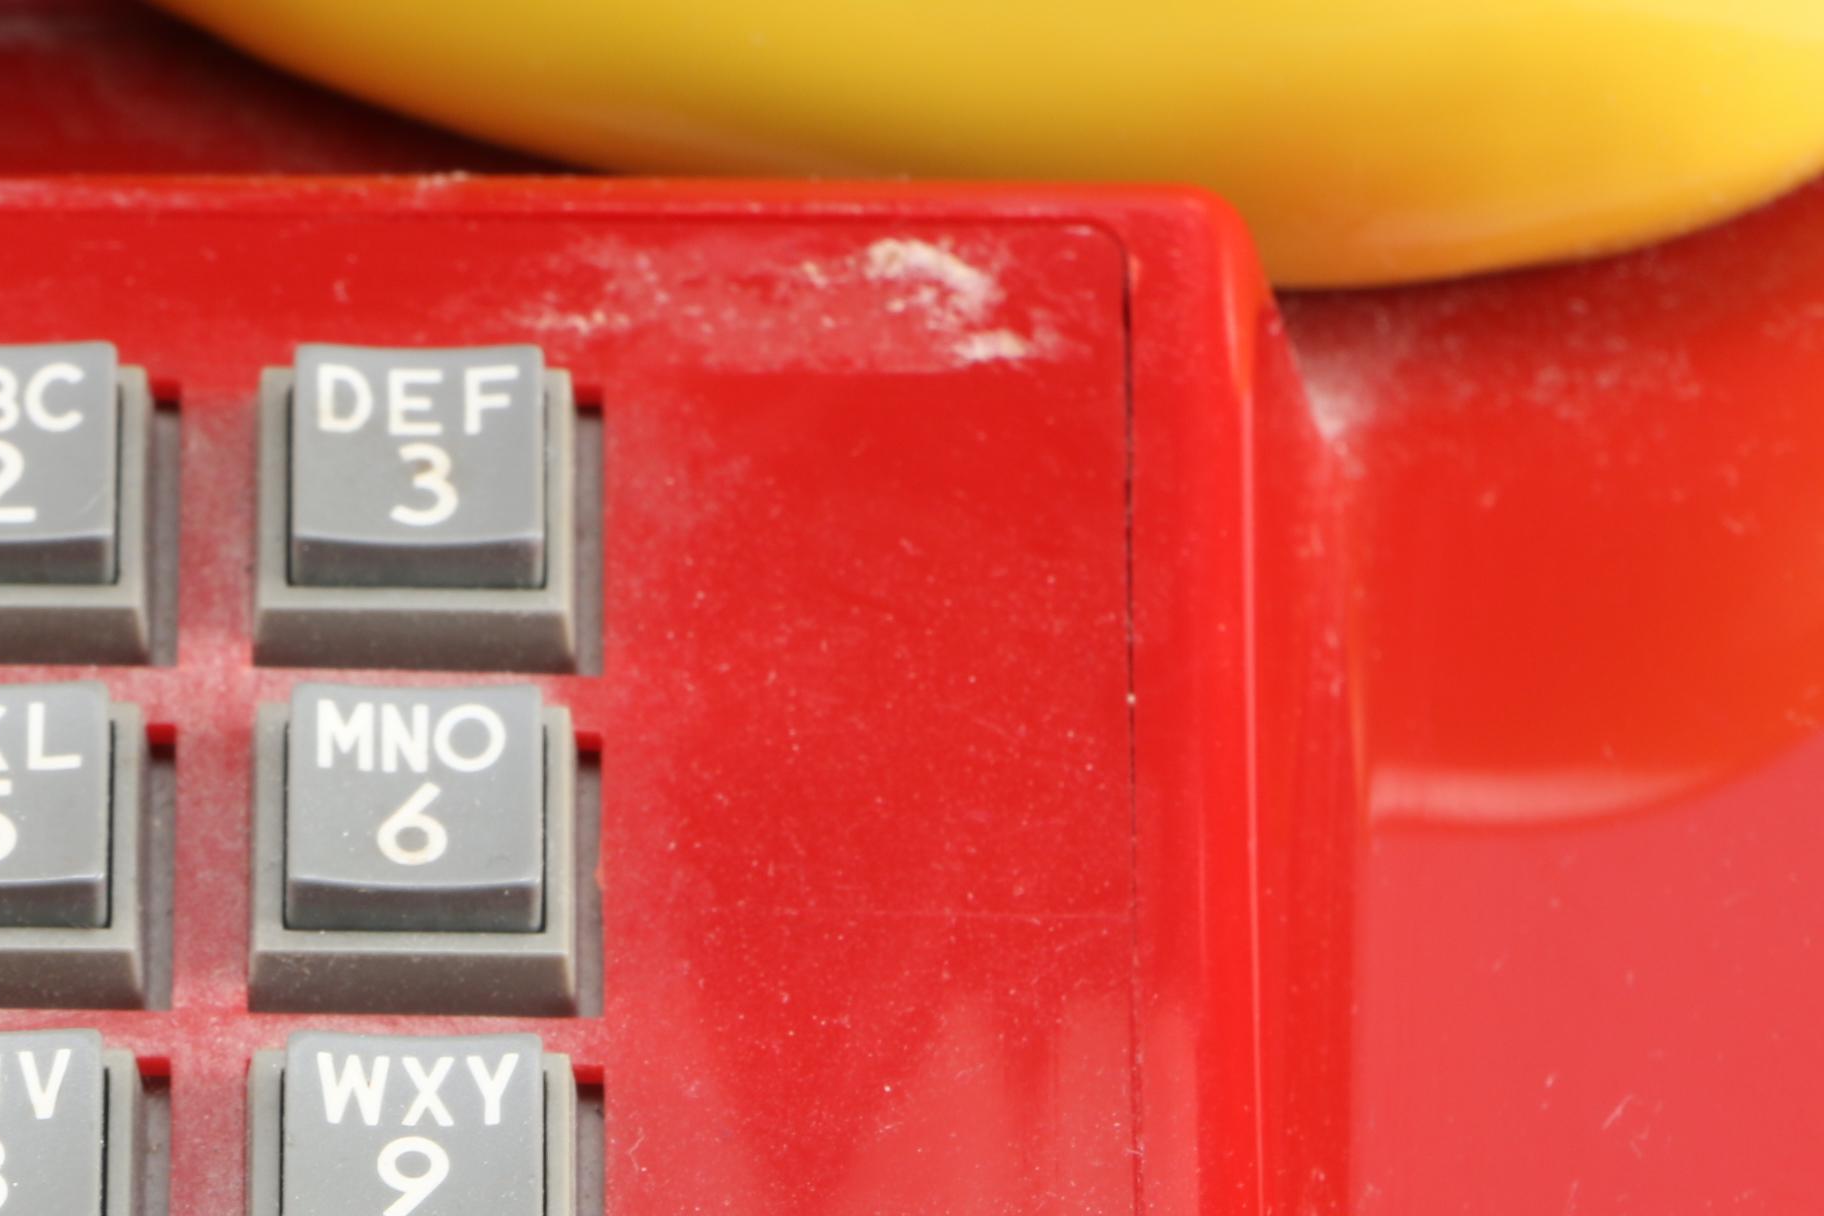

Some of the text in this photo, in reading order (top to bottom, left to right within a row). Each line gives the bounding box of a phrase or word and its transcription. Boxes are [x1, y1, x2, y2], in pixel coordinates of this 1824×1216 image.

[315, 361, 521, 438] DEF
[388, 442, 460, 528] 3
[315, 697, 508, 774] MNO
[376, 780, 450, 867] 6
[315, 1050, 521, 1128] WXY
